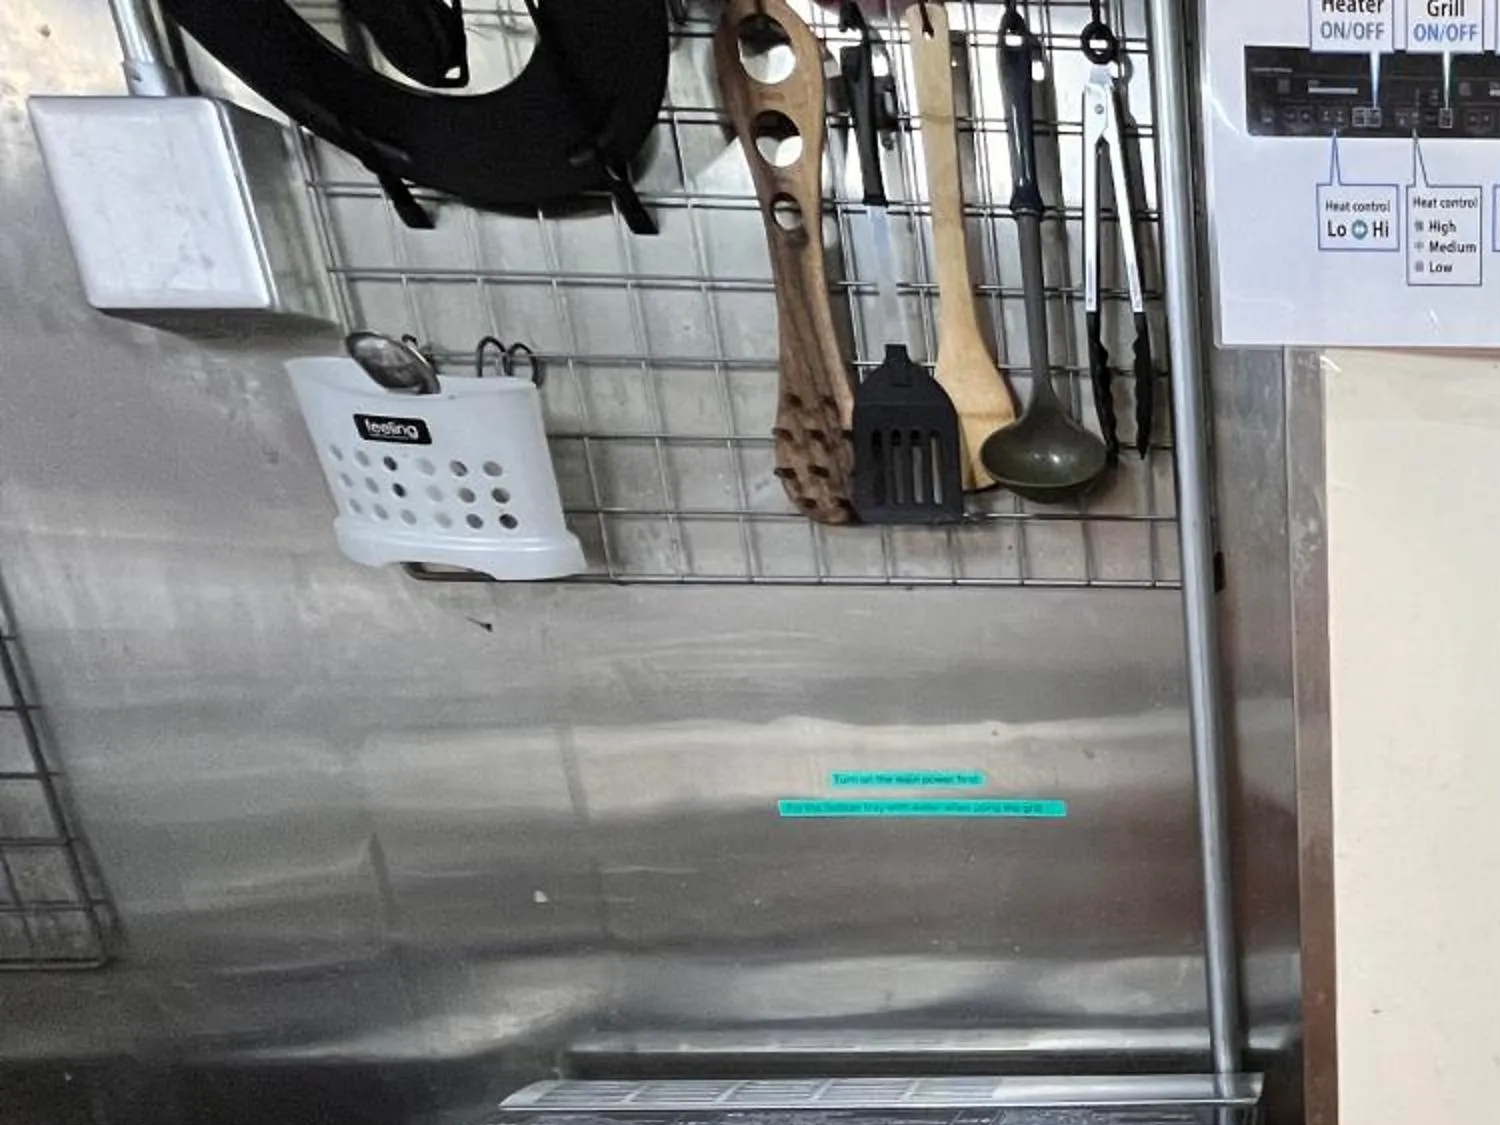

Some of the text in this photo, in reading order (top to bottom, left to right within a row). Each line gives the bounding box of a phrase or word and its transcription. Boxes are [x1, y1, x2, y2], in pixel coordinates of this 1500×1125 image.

[1321, 0, 1384, 13] Heater
[1427, 0, 1465, 17] Grill
[1320, 21, 1384, 39] ON/OFF
[1413, 23, 1478, 42] ON/OFF
[1325, 200, 1391, 212] Heat control
[1413, 196, 1478, 208] Heat control
[1328, 220, 1389, 237] Lo Hi
[1429, 219, 1457, 236] High
[1429, 240, 1477, 253] Medium
[1429, 260, 1453, 273] Low
